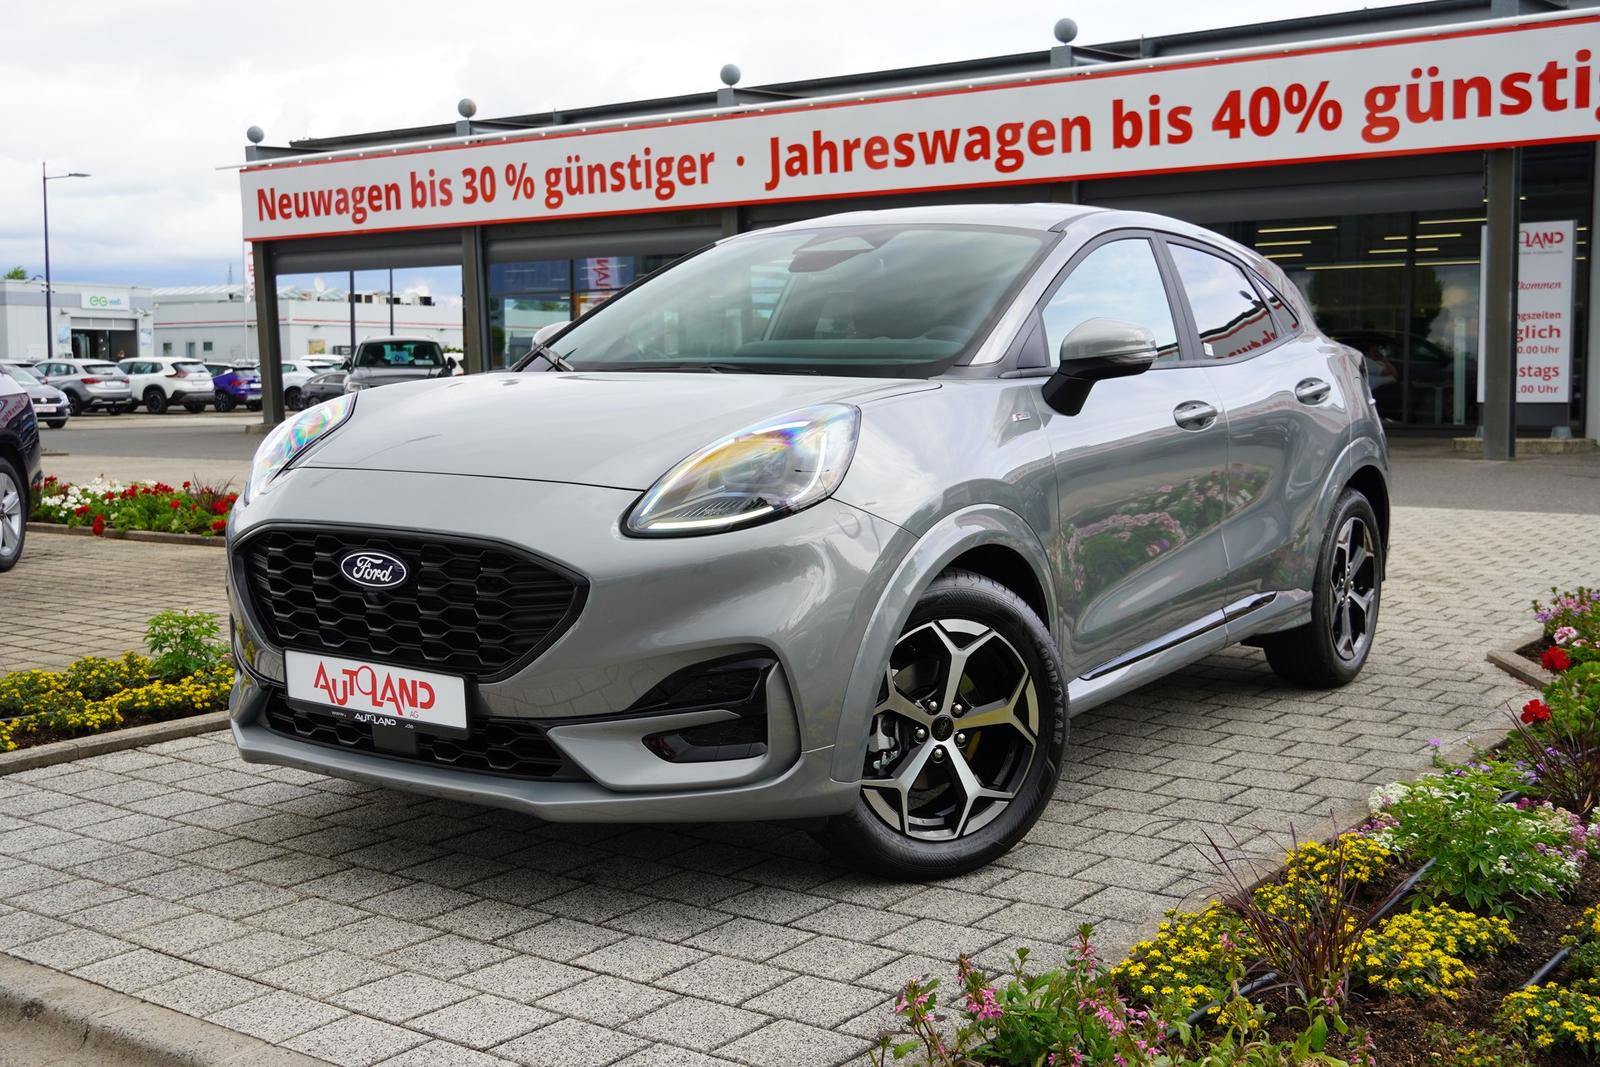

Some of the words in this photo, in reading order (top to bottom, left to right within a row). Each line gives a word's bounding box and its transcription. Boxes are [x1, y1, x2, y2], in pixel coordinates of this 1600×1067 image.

[257, 180, 402, 225] Neuwagen
[410, 169, 453, 209] bis
[462, 165, 497, 205] 30
[504, 162, 536, 201] %
[544, 146, 716, 210] günstiger
[764, 115, 1093, 192] Jahreswagen
[1112, 94, 1194, 150] bis
[1211, 80, 1343, 140] 40%
[1360, 48, 1600, 144] günsti
[1515, 325, 1561, 343] glich
[1516, 345, 1538, 354] 0.00
[1540, 345, 1560, 354] Uhr
[1515, 365, 1560, 381] stags
[1537, 384, 1558, 394] Uhr
[352, 555, 394, 582] Ford
